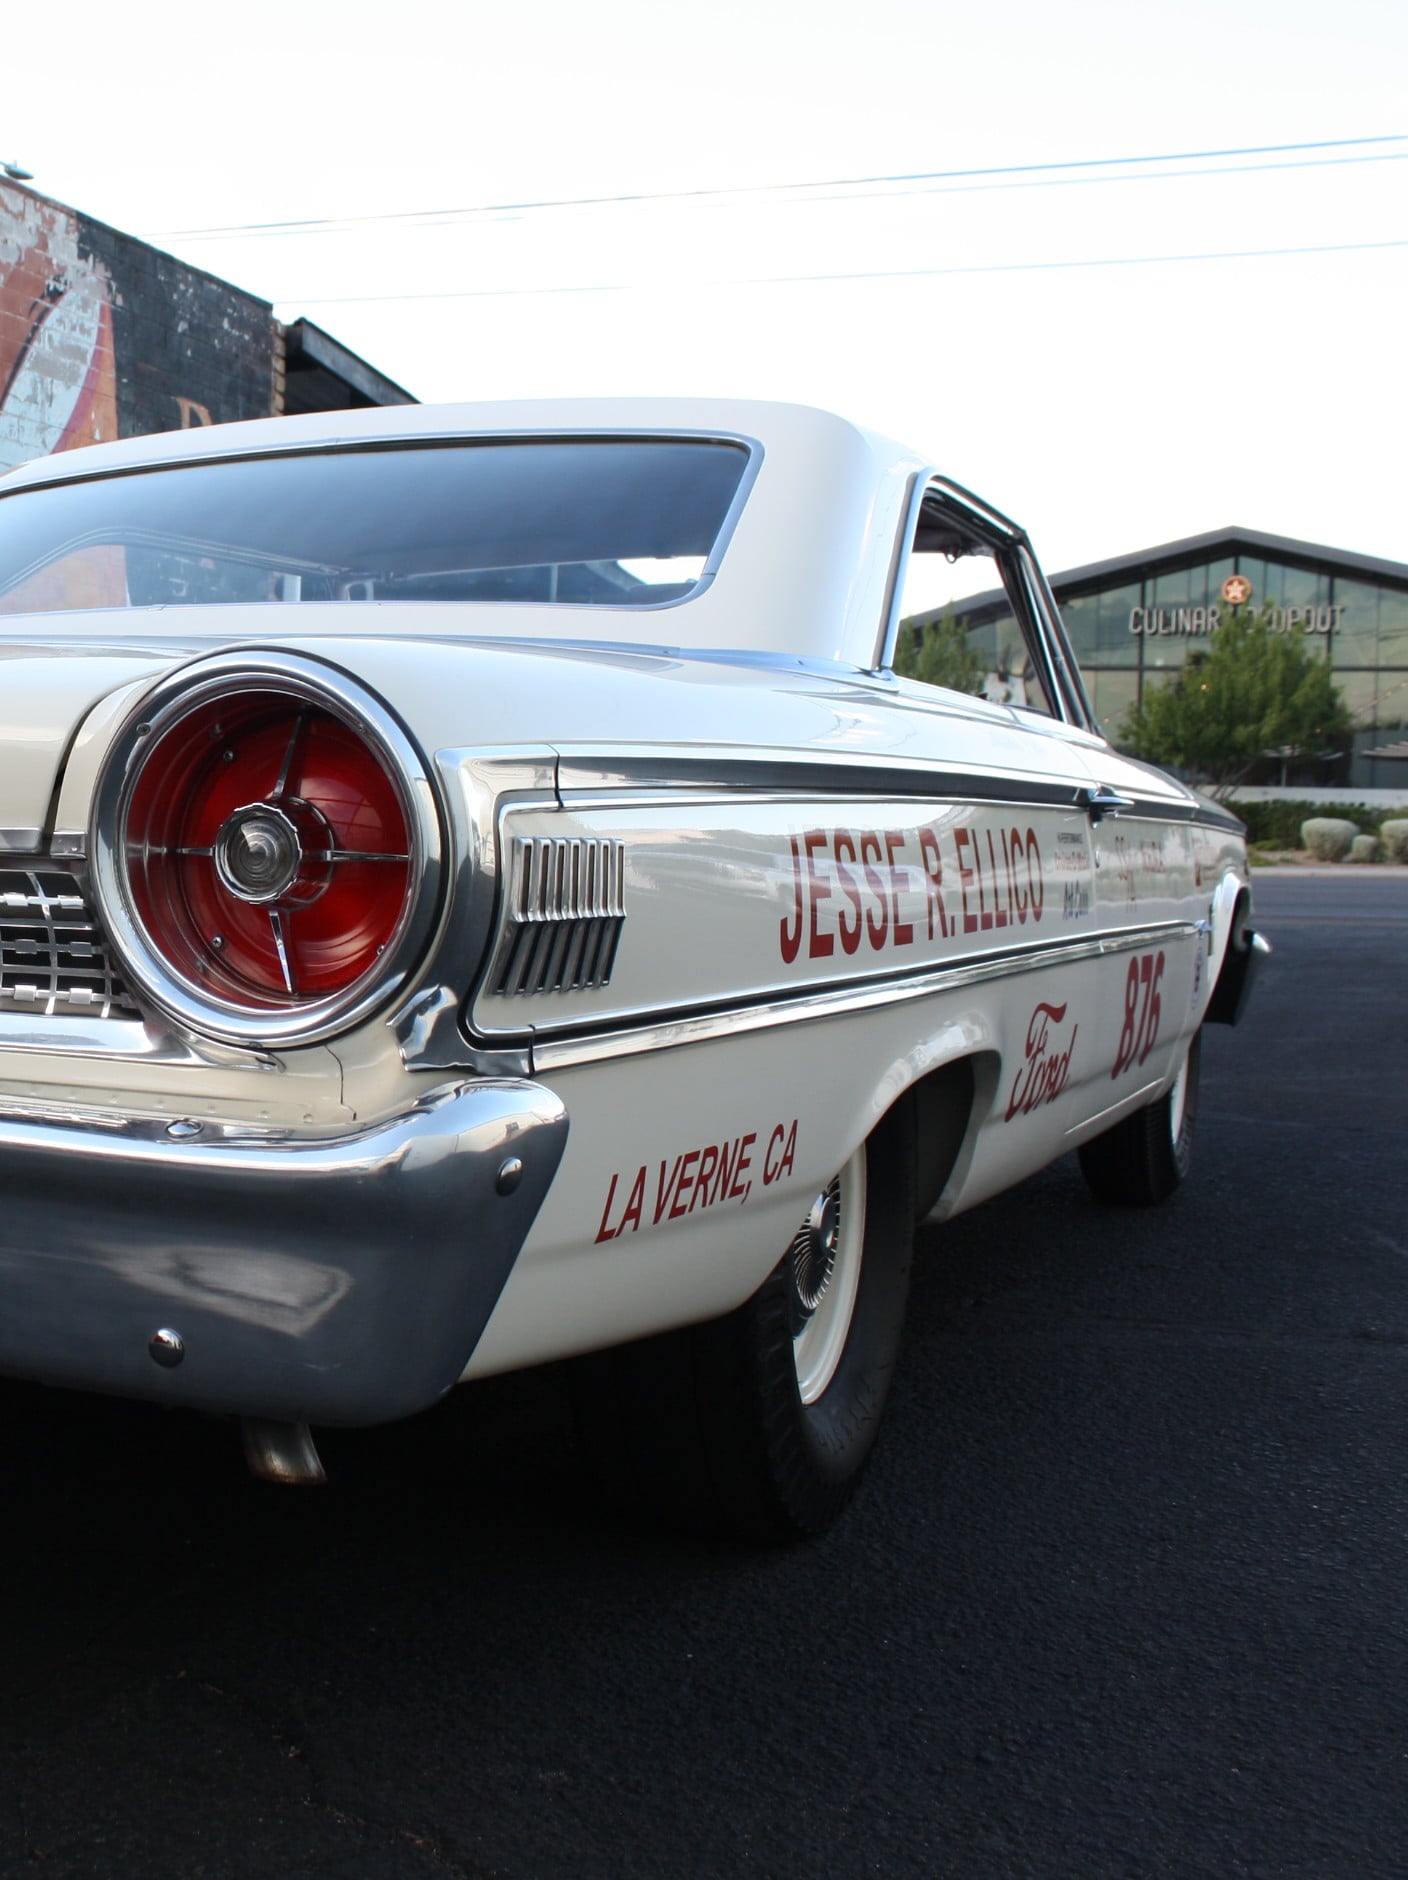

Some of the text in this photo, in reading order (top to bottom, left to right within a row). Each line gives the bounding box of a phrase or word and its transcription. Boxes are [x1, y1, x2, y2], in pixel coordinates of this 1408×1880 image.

[1128, 606, 1235, 634] CULINAR
[779, 828, 914, 964] JESSE
[917, 827, 956, 941] R.
[954, 826, 1044, 934] ELLICO
[1004, 1001, 1079, 1123] Ford
[1111, 950, 1166, 1081] 876
[594, 1118, 799, 1245] LA VERNE, CA
